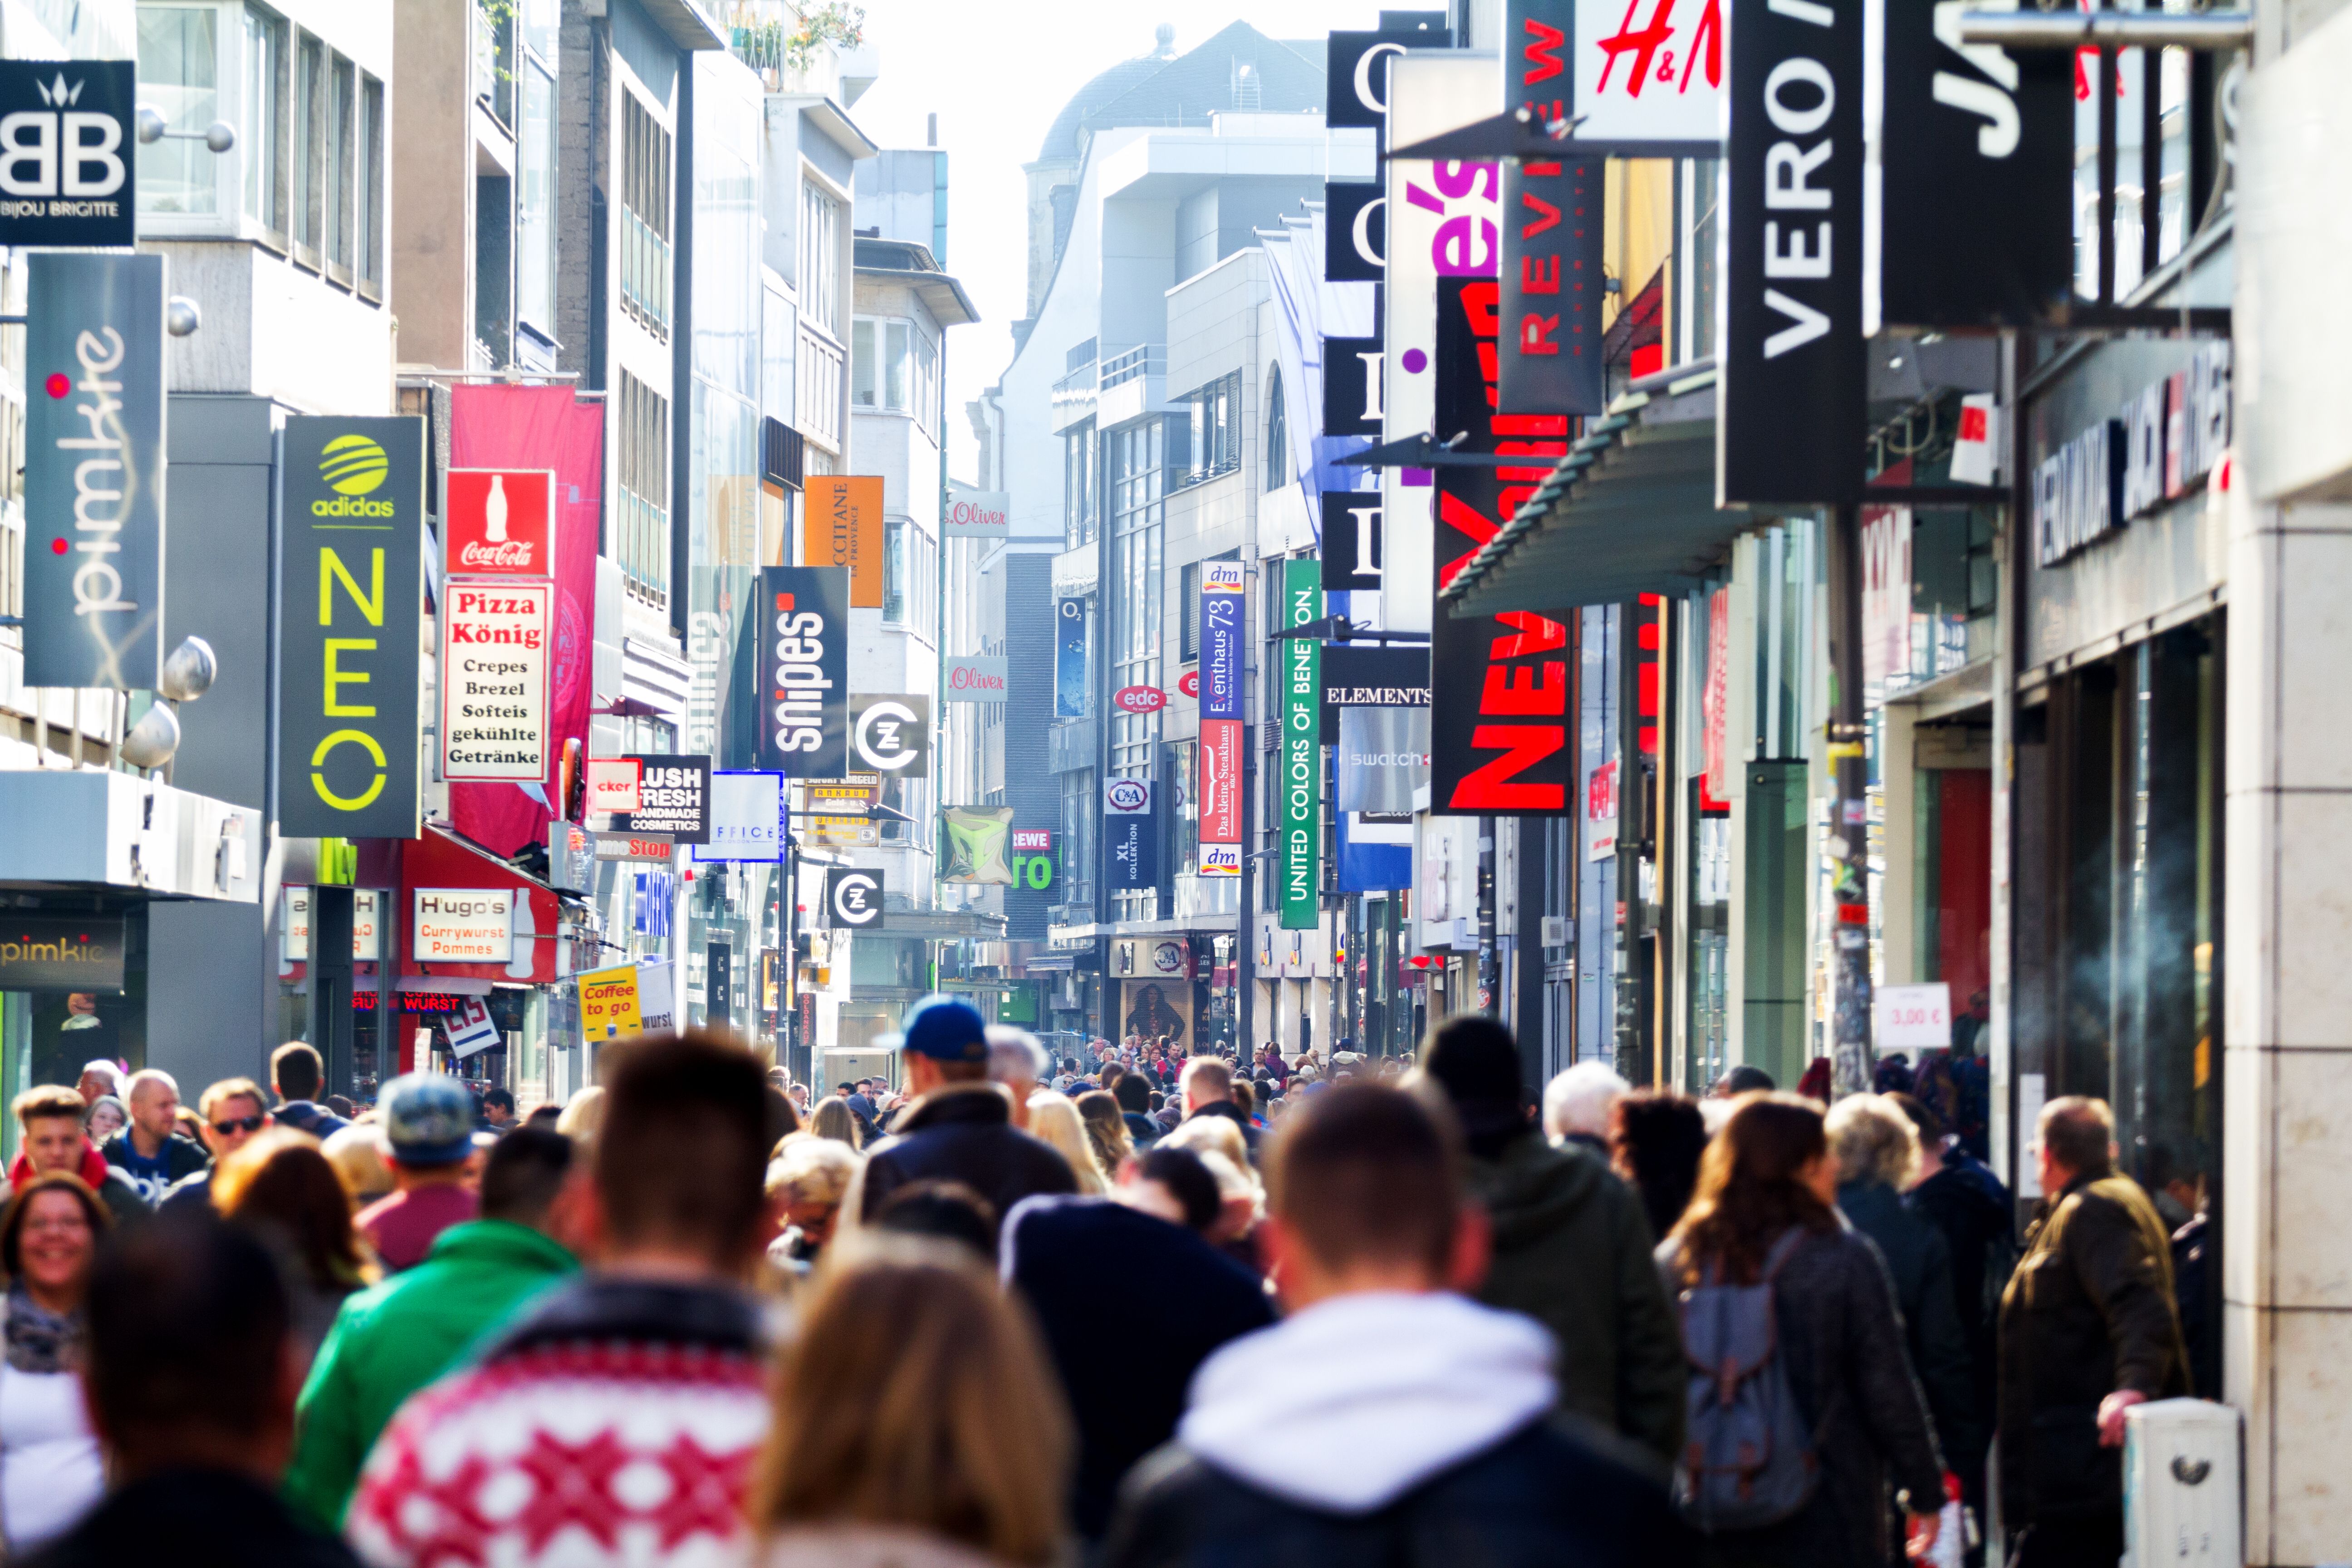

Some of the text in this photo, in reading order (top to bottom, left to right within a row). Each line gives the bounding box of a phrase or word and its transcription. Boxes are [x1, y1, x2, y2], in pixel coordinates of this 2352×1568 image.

[0, 201, 119, 219] BIJOU BRIGITTE
[1763, 56, 1835, 359] VERO
[73, 326, 138, 615] pimkie
[311, 496, 394, 517] adidas
[833, 483, 847, 566] CCITANE
[1210, 566, 1238, 582] dm
[457, 593, 535, 614] Pizza
[452, 623, 541, 649] König
[1208, 600, 1234, 711] Eventhaus 73
[464, 660, 527, 675] Crepes
[311, 548, 387, 810] NEO
[775, 611, 832, 751] snipes
[949, 666, 1004, 690] .Oliver
[466, 682, 524, 695] Brezel
[1124, 690, 1158, 706] edc
[462, 705, 528, 718] Softeis
[452, 728, 537, 743] gekühlte
[1291, 586, 1312, 900] UNITED COLORS OF BENEON.
[449, 750, 539, 763] Getränke
[1351, 752, 1421, 766] swatch
[639, 768, 701, 788] USH
[1218, 725, 1229, 837] Das kleine Steakhaus
[597, 781, 631, 792] cker
[639, 789, 701, 806] RESH
[1115, 789, 1141, 802] C&A
[631, 820, 700, 830] COSMETICS
[718, 826, 773, 838] FFICE
[1014, 833, 1047, 847] REWE
[1117, 842, 1128, 861] XL
[1208, 848, 1235, 864] dm
[422, 925, 505, 940] Currywurst
[432, 941, 493, 954] Pommes
[584, 985, 634, 999] Coffee
[404, 998, 459, 1010] WURST
[588, 1002, 631, 1016] to go
